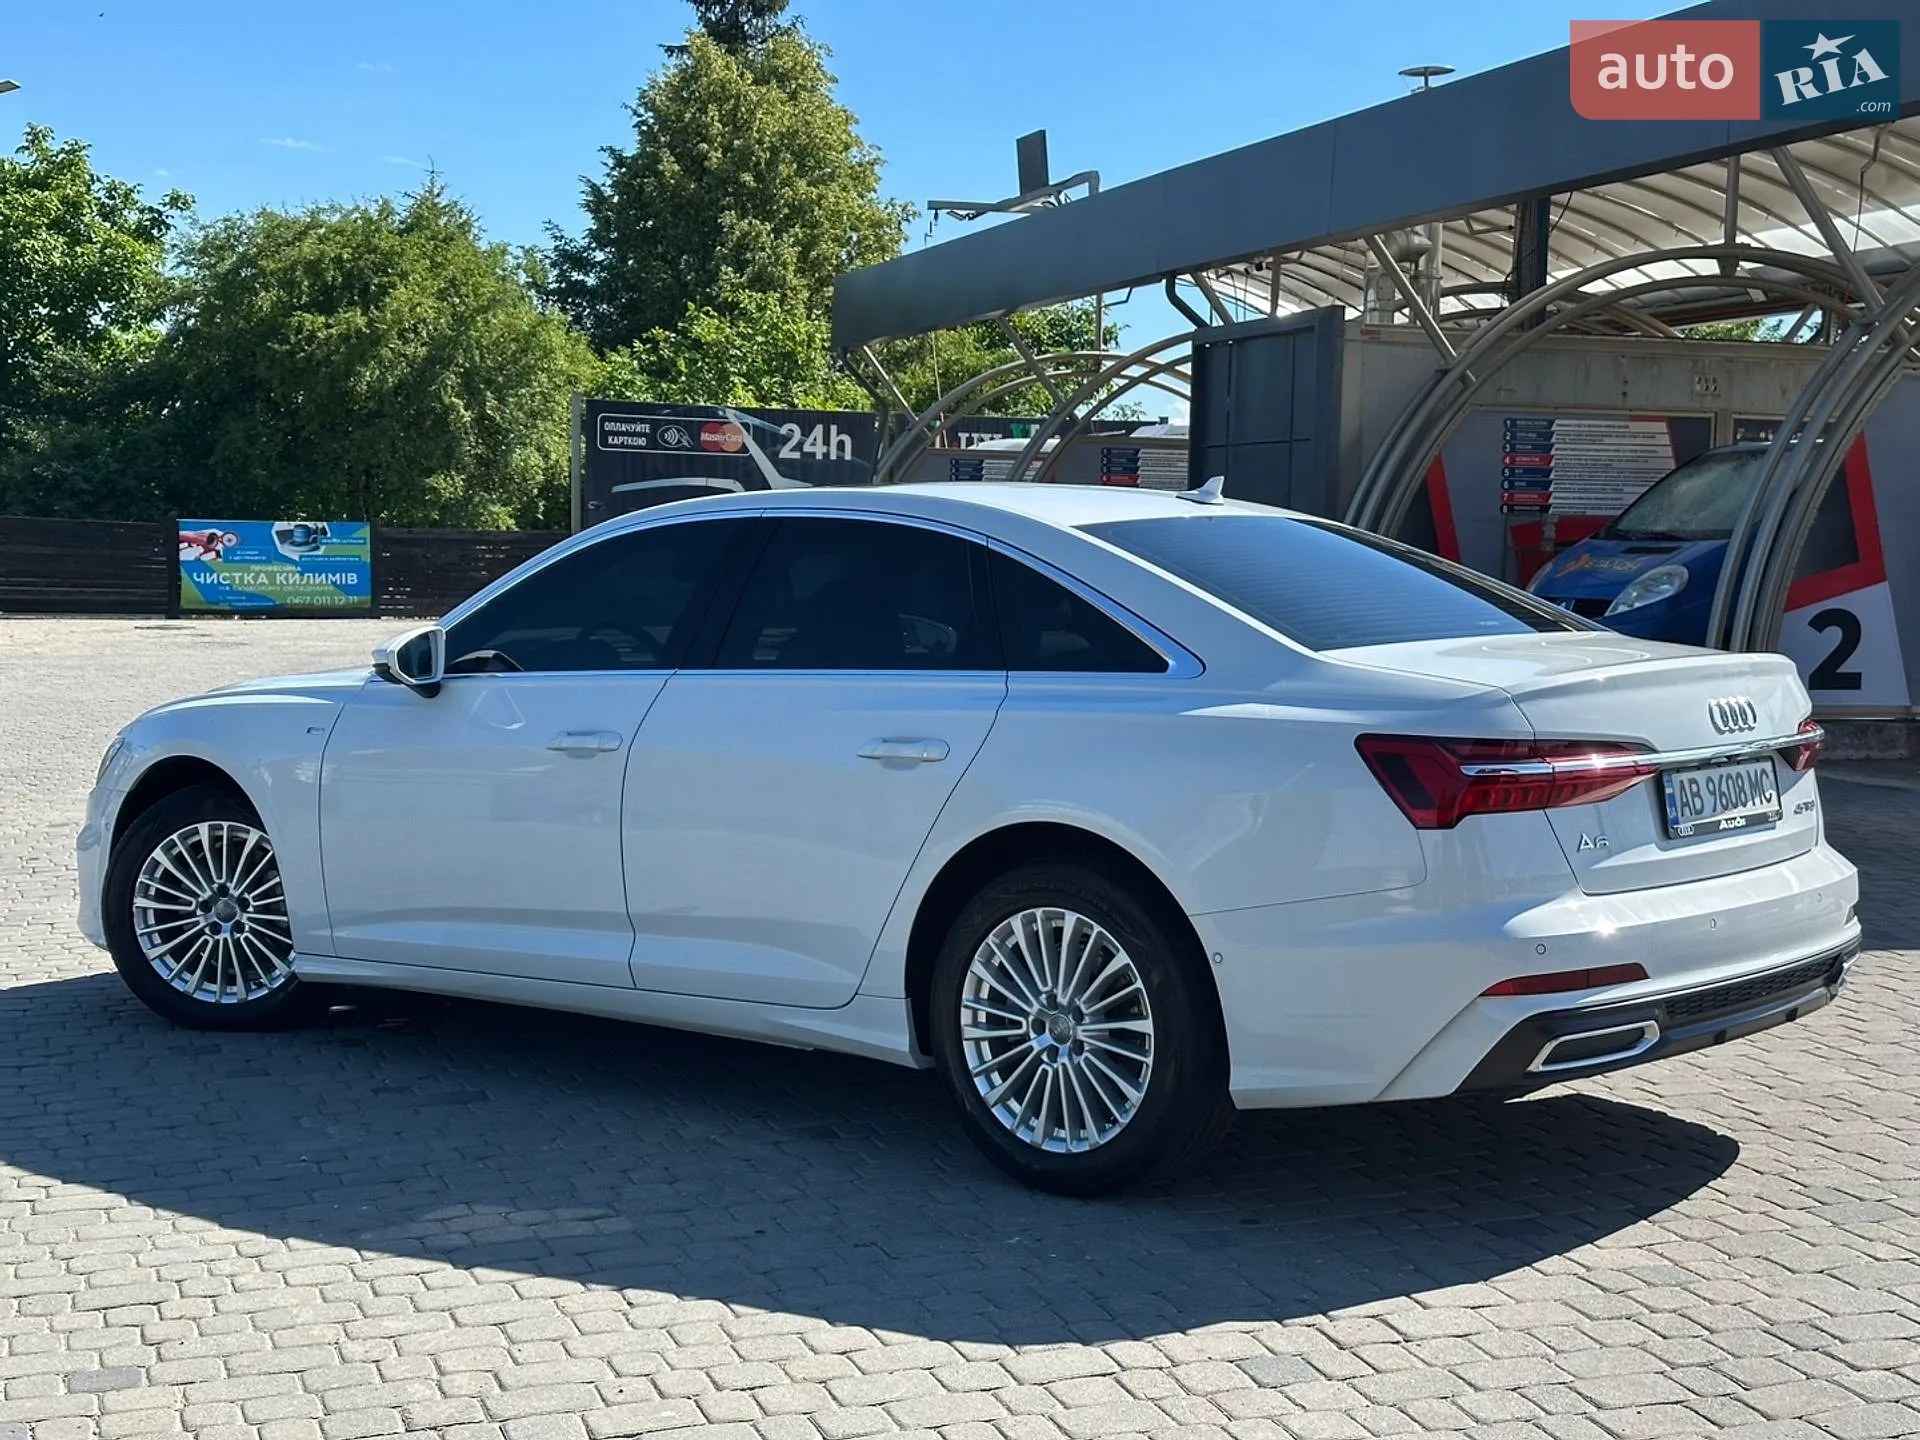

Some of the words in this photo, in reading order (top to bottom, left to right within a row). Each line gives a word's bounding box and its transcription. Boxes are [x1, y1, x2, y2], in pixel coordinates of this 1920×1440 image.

[603, 421, 651, 434] ОПЛАЧУЙТЕ
[607, 436, 647, 447] КАРТКОЮ
[777, 423, 852, 461] 24h
[193, 572, 269, 585] ЧИСТКА
[276, 572, 358, 585] КИЛИМІВ
[1808, 608, 1862, 690] 2
[1679, 776, 1704, 817] AB
[1706, 770, 1748, 812] 9608
[1747, 767, 1773, 806] MC
[1577, 832, 1610, 852] A6
